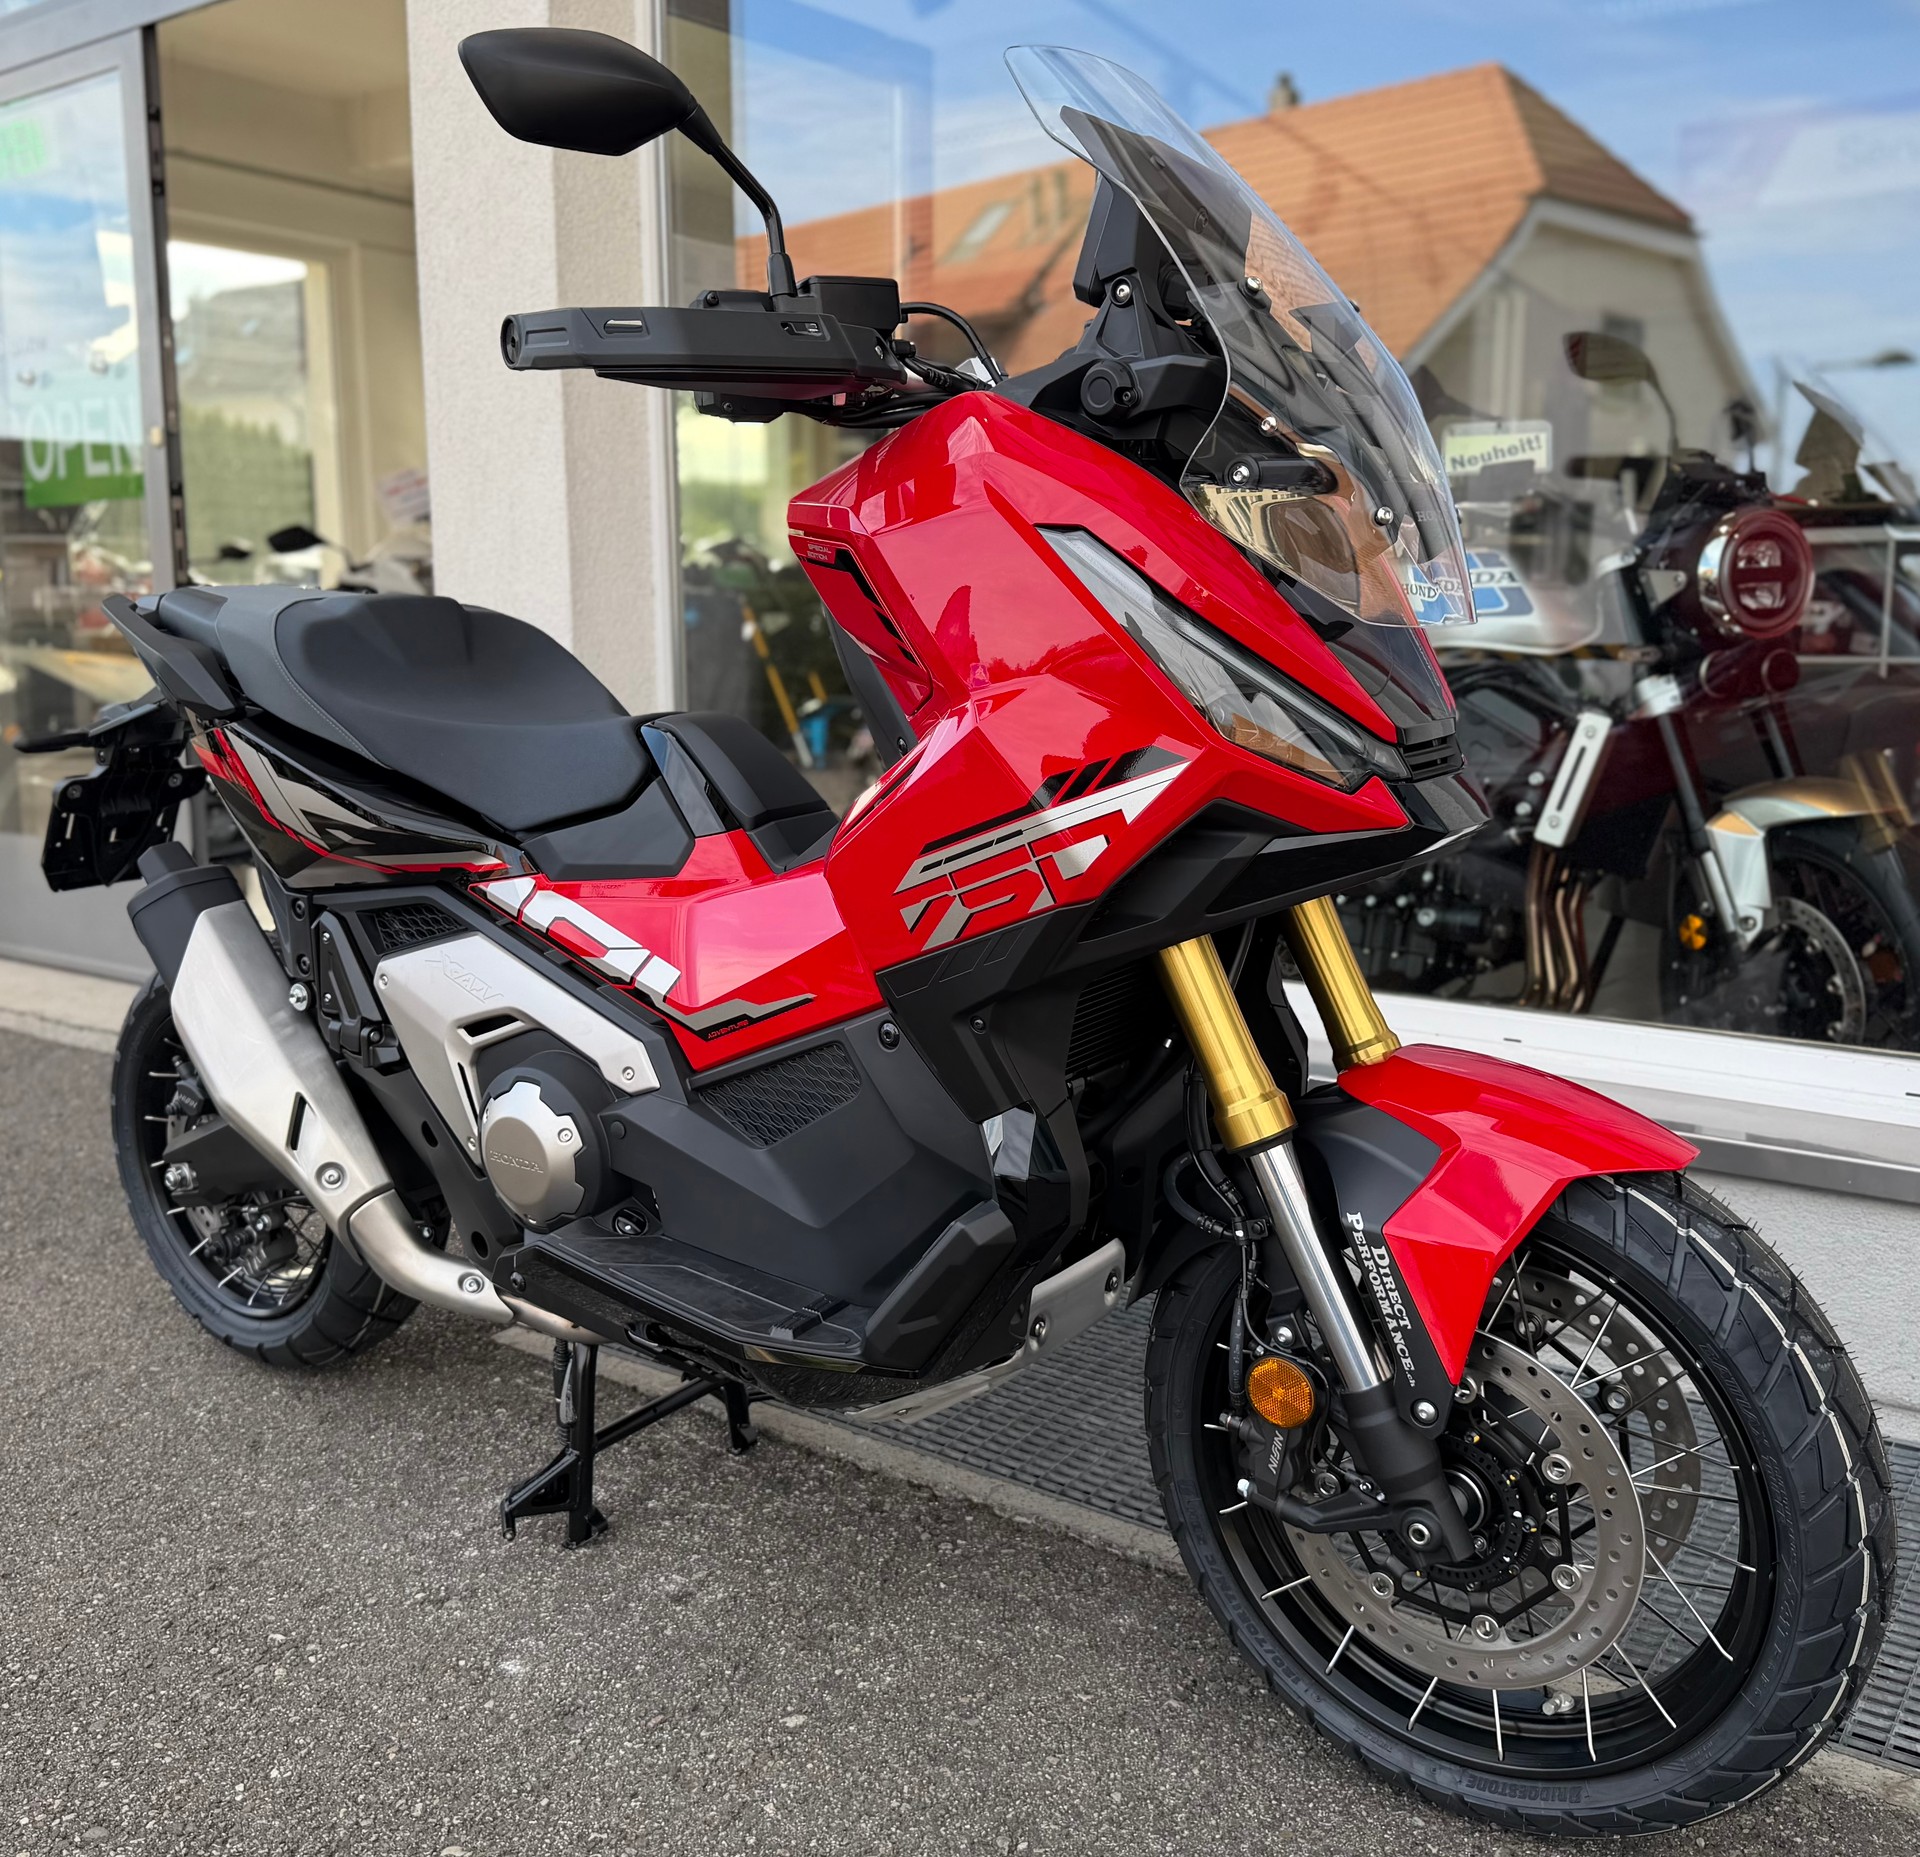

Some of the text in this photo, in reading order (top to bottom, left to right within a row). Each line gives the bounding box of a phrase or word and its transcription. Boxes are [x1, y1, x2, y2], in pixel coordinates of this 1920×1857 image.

[24, 398, 142, 483] OPEN
[1450, 435, 1541, 470] Neuheit!
[708, 1019, 749, 1039] ADVENTURE
[489, 1150, 544, 1174] HONDA
[1371, 1245, 1412, 1333] DIRECT
[1465, 1774, 1583, 1804] BRIDGESTONE
